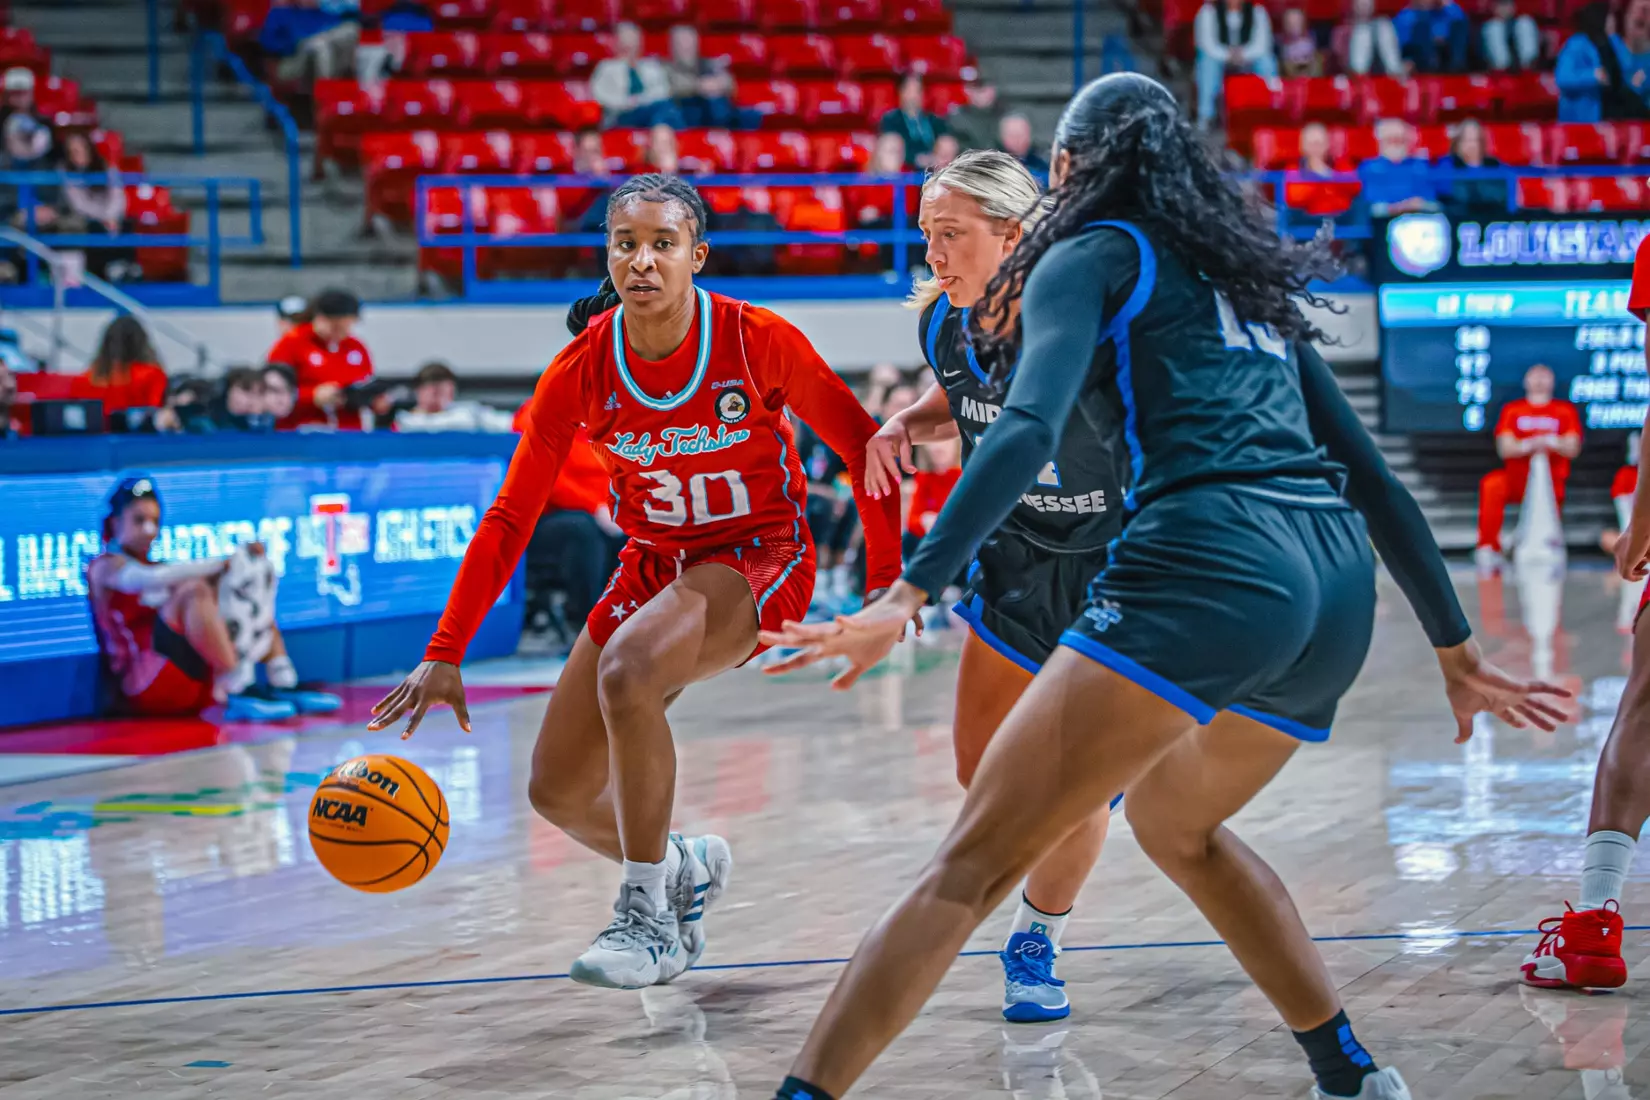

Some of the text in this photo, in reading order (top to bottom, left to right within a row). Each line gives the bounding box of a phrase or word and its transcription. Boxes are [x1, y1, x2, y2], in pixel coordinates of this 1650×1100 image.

[1457, 220, 1650, 267] LOUISIAN
[605, 422, 751, 466] Lady Techsters
[638, 469, 752, 527] 30
[326, 759, 400, 798] ilson
[313, 797, 368, 827] NCAA
